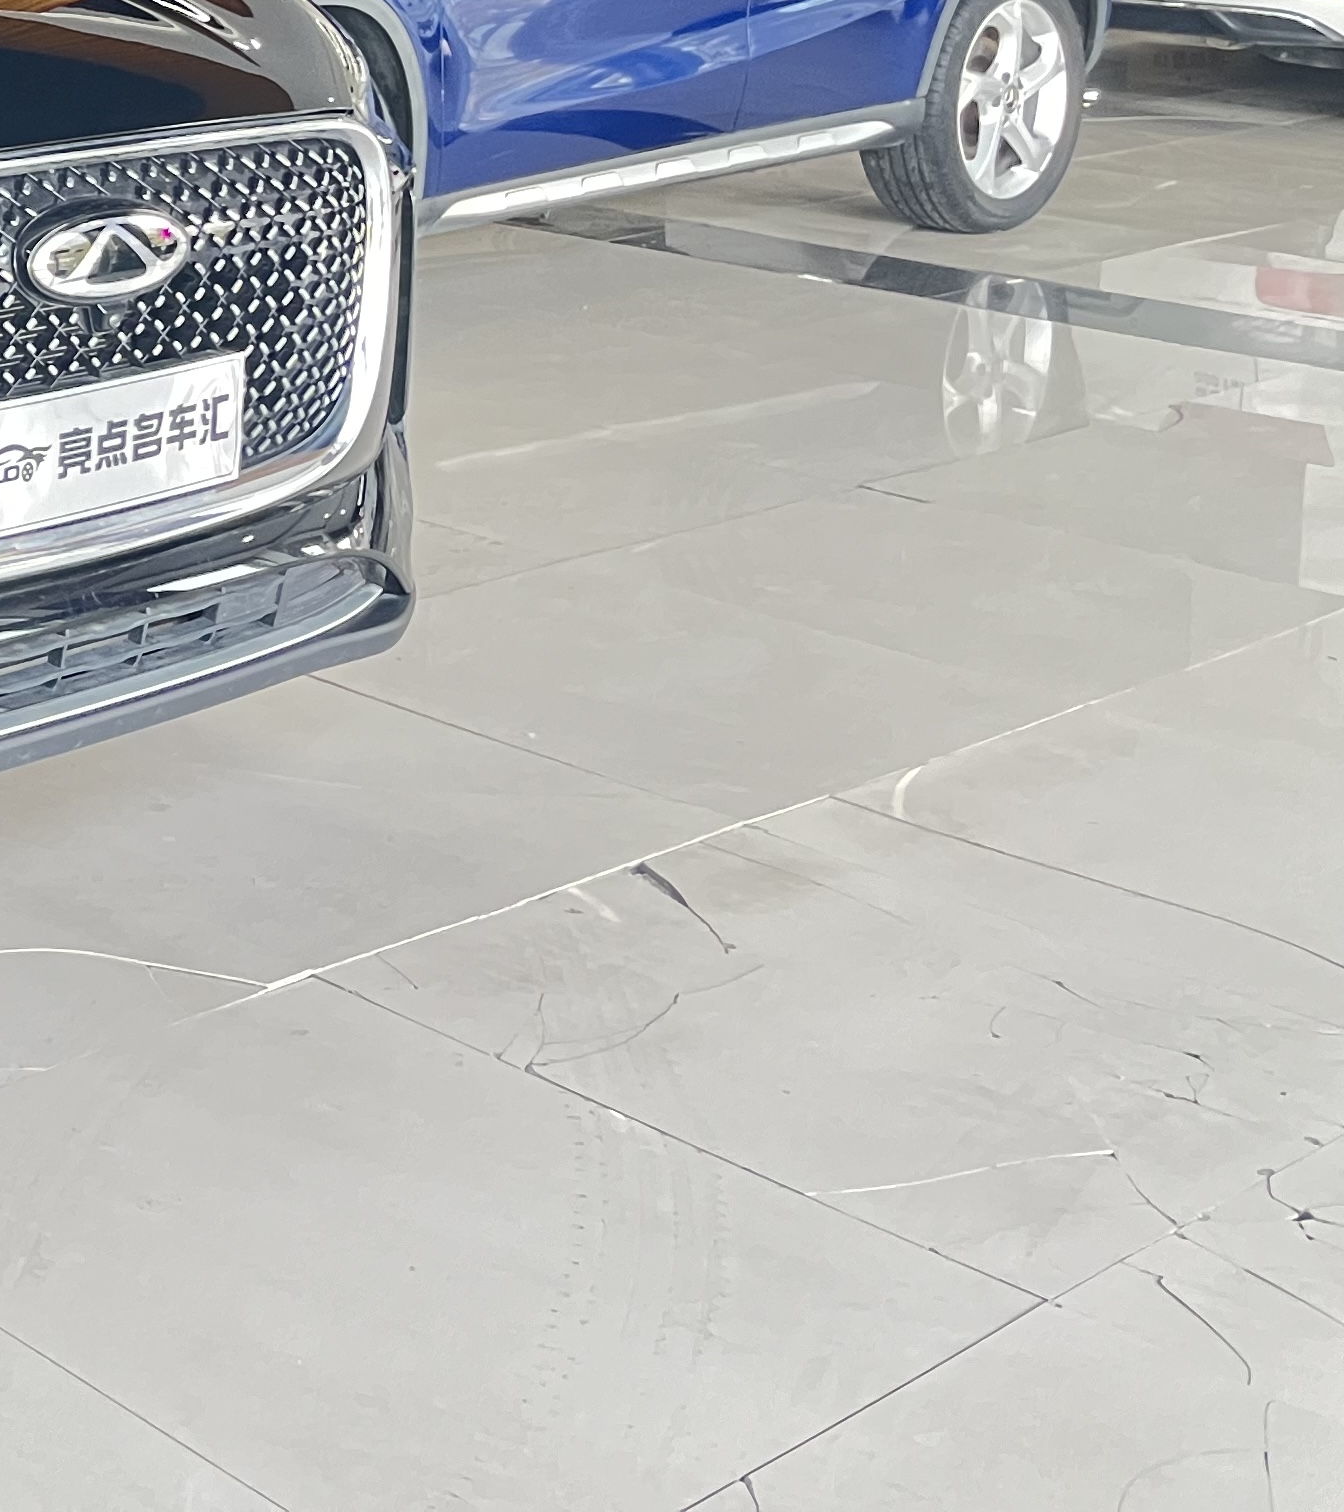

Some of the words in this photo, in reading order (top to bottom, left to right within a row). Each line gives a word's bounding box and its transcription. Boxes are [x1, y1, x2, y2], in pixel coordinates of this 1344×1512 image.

[57, 393, 230, 480] 亮点名车汇
